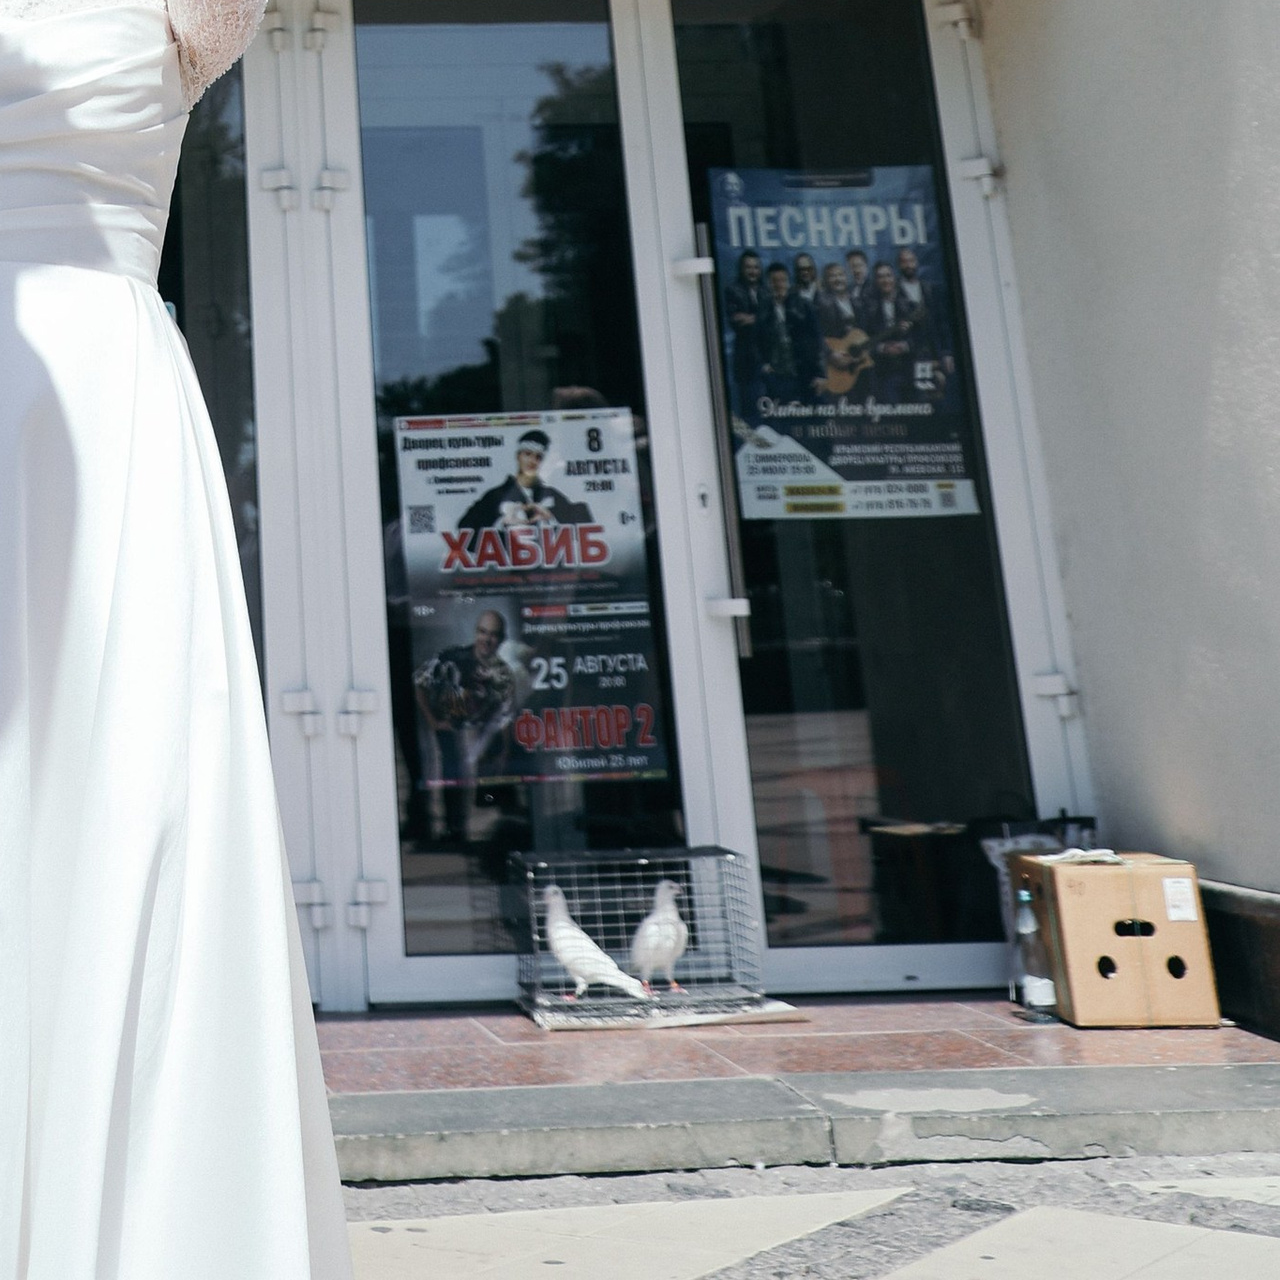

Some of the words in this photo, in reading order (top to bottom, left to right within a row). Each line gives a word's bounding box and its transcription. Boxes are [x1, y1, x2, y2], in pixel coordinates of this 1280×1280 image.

[727, 203, 929, 248] ПЕСНЯРЫ
[586, 427, 603, 452] 8
[565, 458, 631, 476] АВГУСТА
[440, 525, 611, 572] ХАБИБ
[530, 655, 569, 691] 25
[573, 652, 649, 674] АВГУСТА
[515, 704, 632, 752] ФАКТОР
[634, 702, 658, 747] 2
